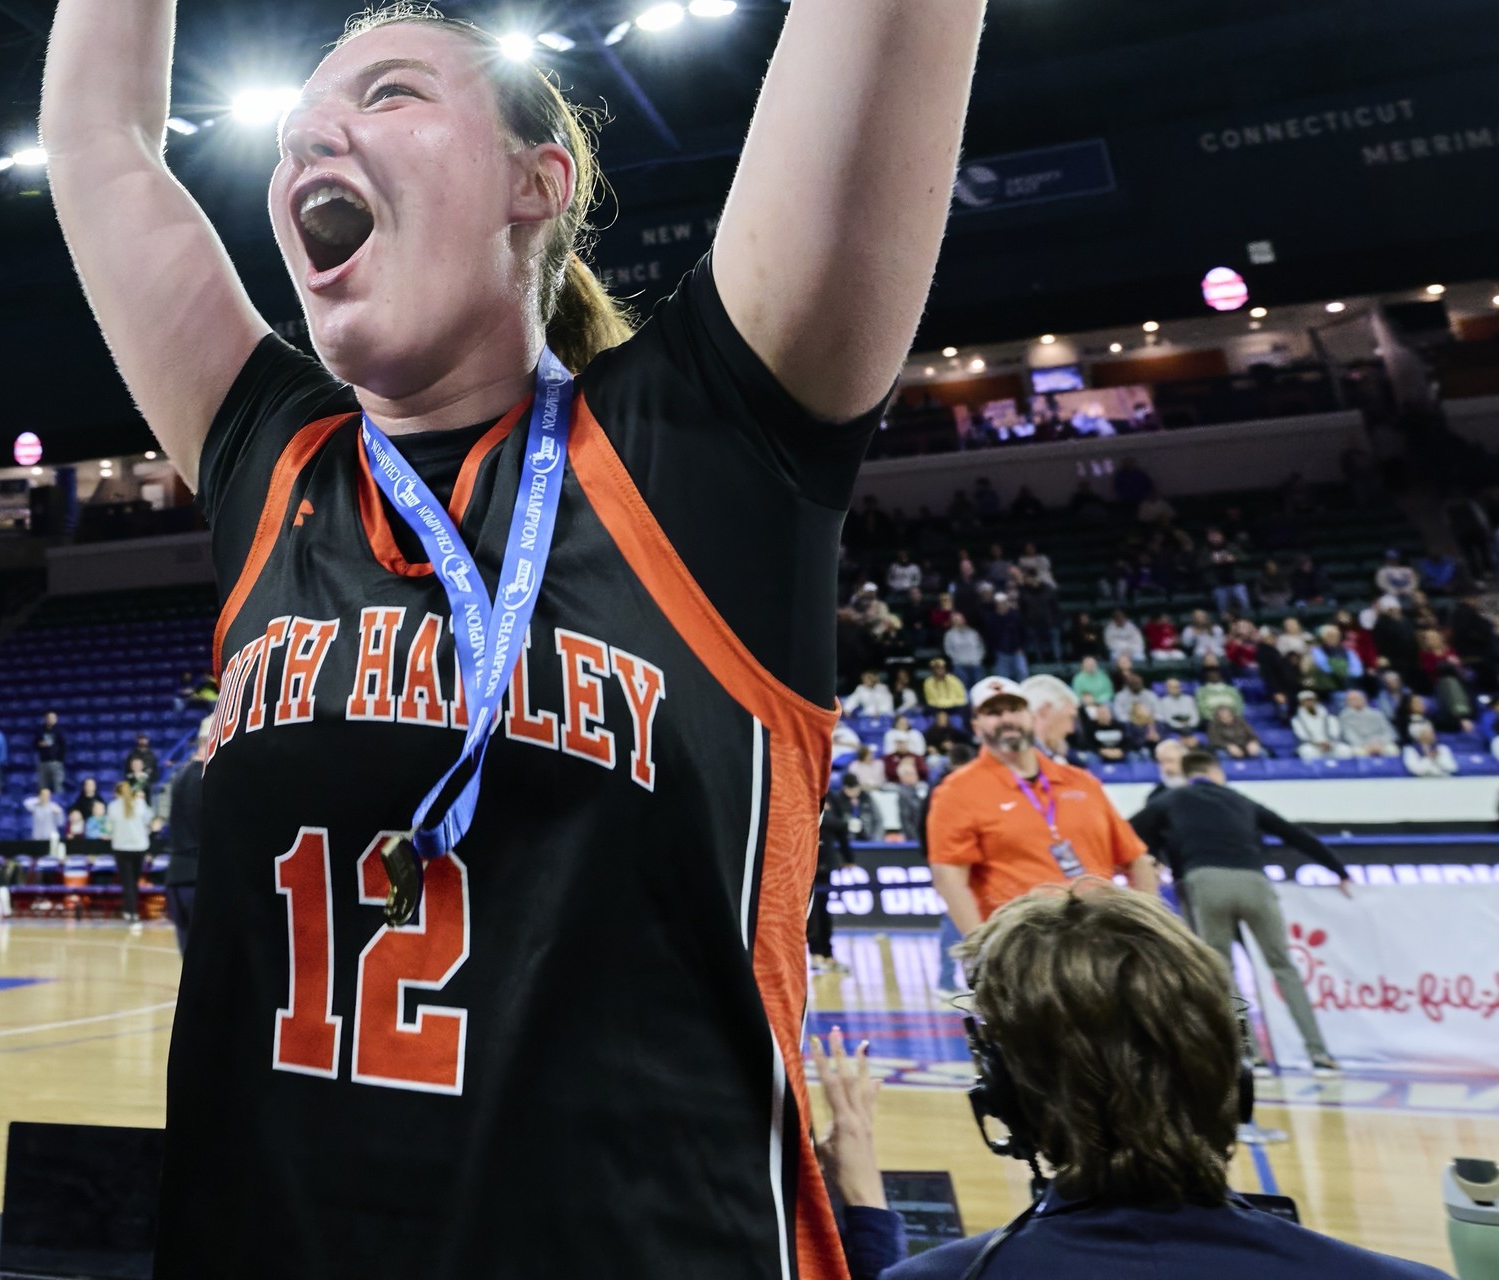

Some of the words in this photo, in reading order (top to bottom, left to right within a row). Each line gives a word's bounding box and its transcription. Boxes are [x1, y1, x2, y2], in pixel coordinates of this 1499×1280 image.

[1198, 97, 1416, 154] CONNECTICUT
[1360, 126, 1499, 167] MERRIM
[641, 221, 693, 247] NEW
[541, 385, 561, 432] CHAMPION
[370, 437, 401, 482] CHAMPION
[415, 503, 456, 555] CHAMPION
[520, 473, 548, 552] CHAMPION
[484, 611, 517, 699] CHAMPION
[202, 615, 341, 781] OUTH
[272, 825, 471, 1097] 12
